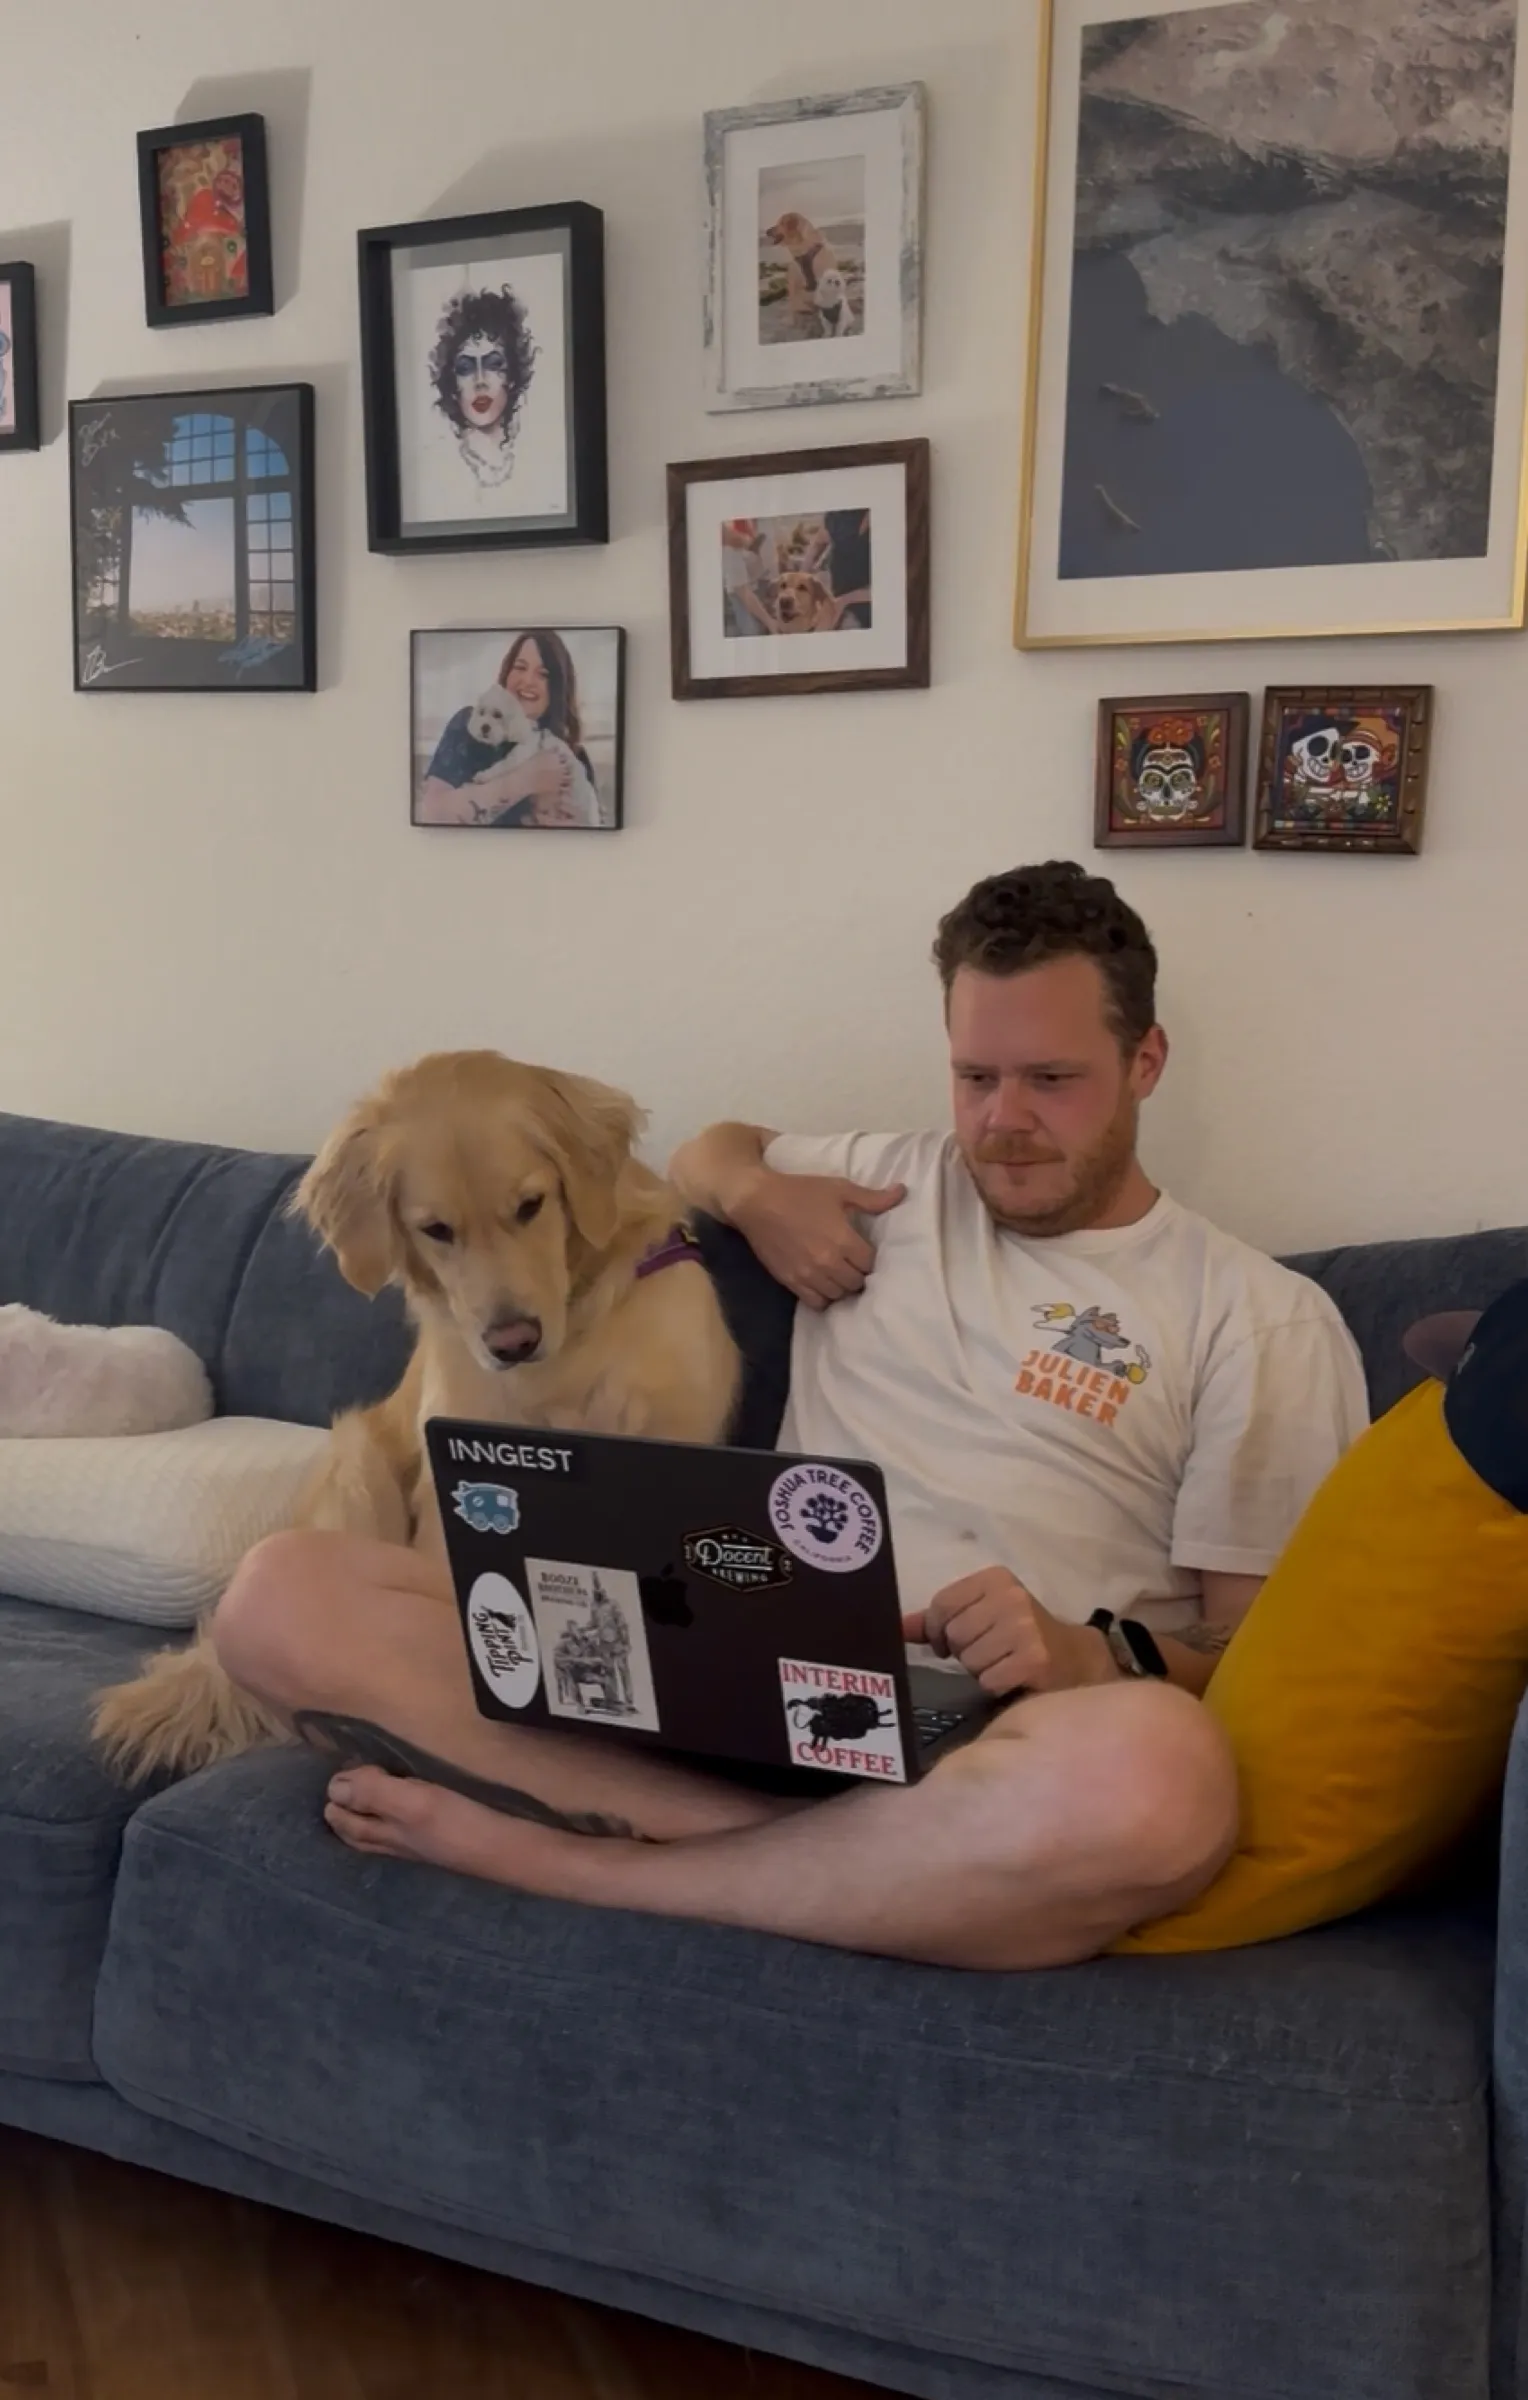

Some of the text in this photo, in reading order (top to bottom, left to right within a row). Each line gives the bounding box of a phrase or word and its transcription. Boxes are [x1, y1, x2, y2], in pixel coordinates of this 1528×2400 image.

[1015, 1370, 1119, 1428] BAKER
[1022, 1350, 1130, 1405] JULIEN
[447, 1437, 573, 1472] INNGEST
[774, 1469, 877, 1555] JOSHUA TREE COFFEE
[782, 1662, 893, 1699] INTERIM
[796, 1740, 898, 1776] COFFEE
